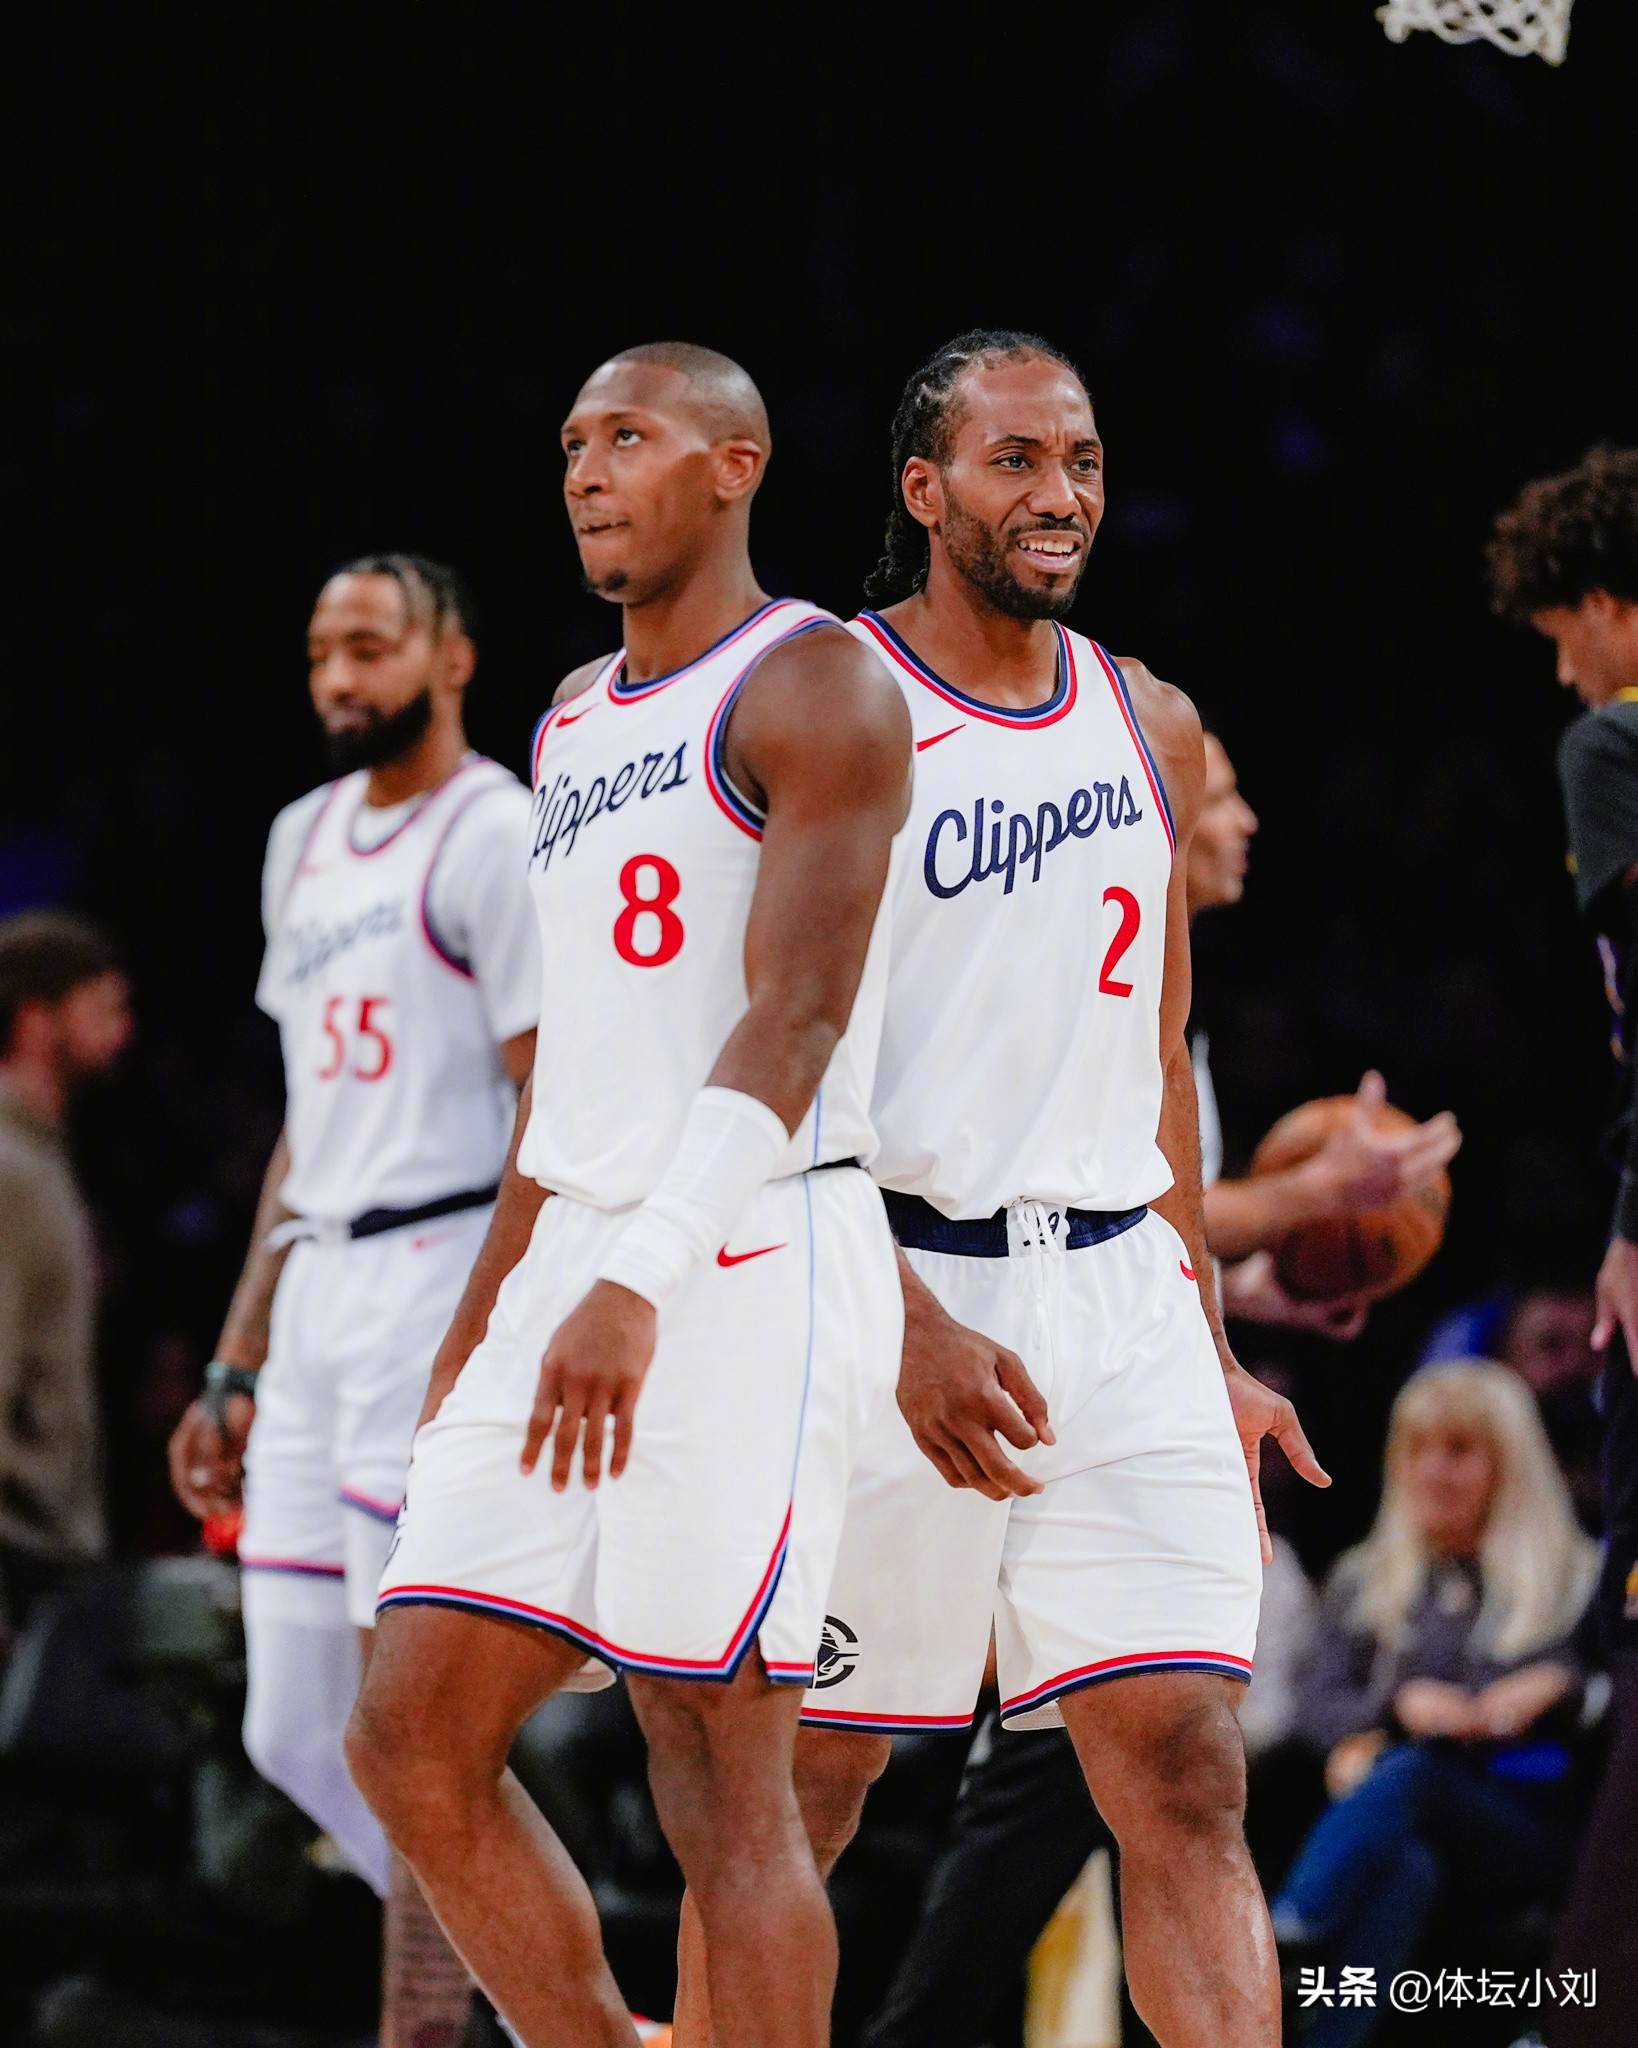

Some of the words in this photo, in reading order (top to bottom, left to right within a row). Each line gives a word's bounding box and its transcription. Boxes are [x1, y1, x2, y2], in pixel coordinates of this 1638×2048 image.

[923, 774, 1143, 899] Clippers
[613, 853, 685, 968] 8
[1098, 886, 1141, 998] 2
[319, 994, 394, 1082] 55
